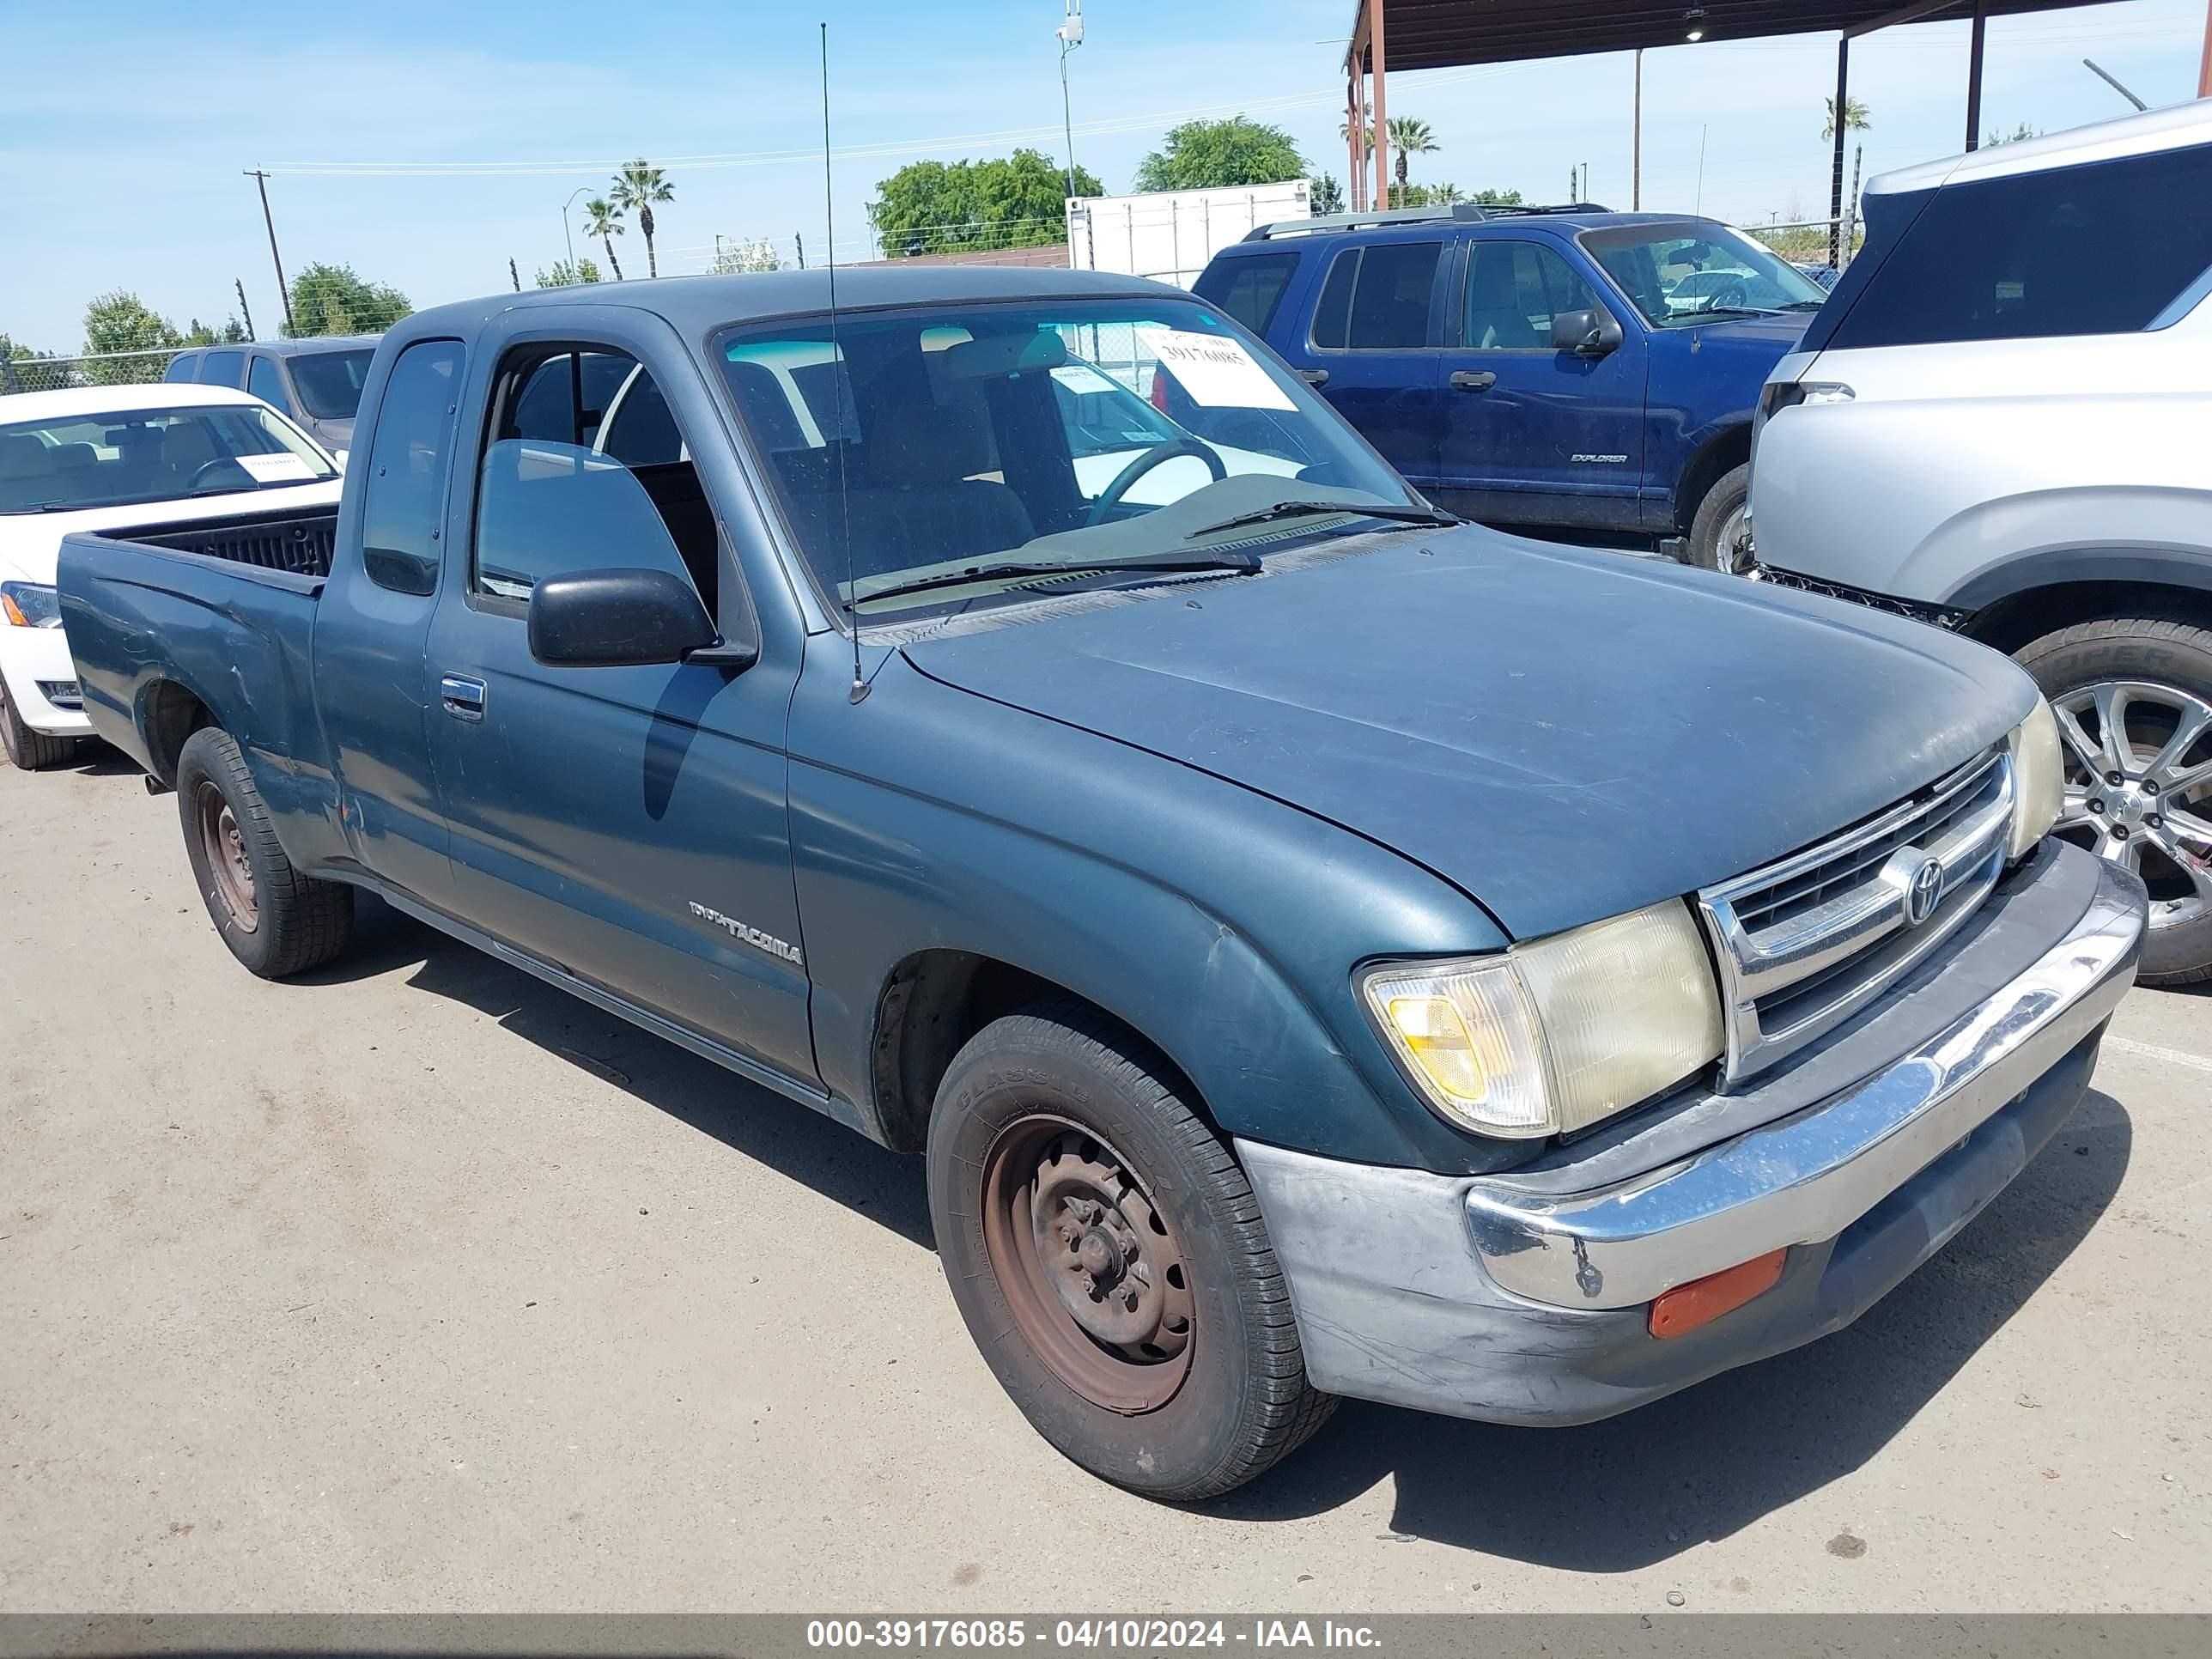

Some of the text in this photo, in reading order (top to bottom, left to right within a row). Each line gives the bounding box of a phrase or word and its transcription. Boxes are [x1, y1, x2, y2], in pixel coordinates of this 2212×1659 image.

[1162, 345, 1245, 366] 39176085
[1571, 453, 1628, 463] EXPLORER
[689, 900, 804, 966] TOYOTA TACOMA
